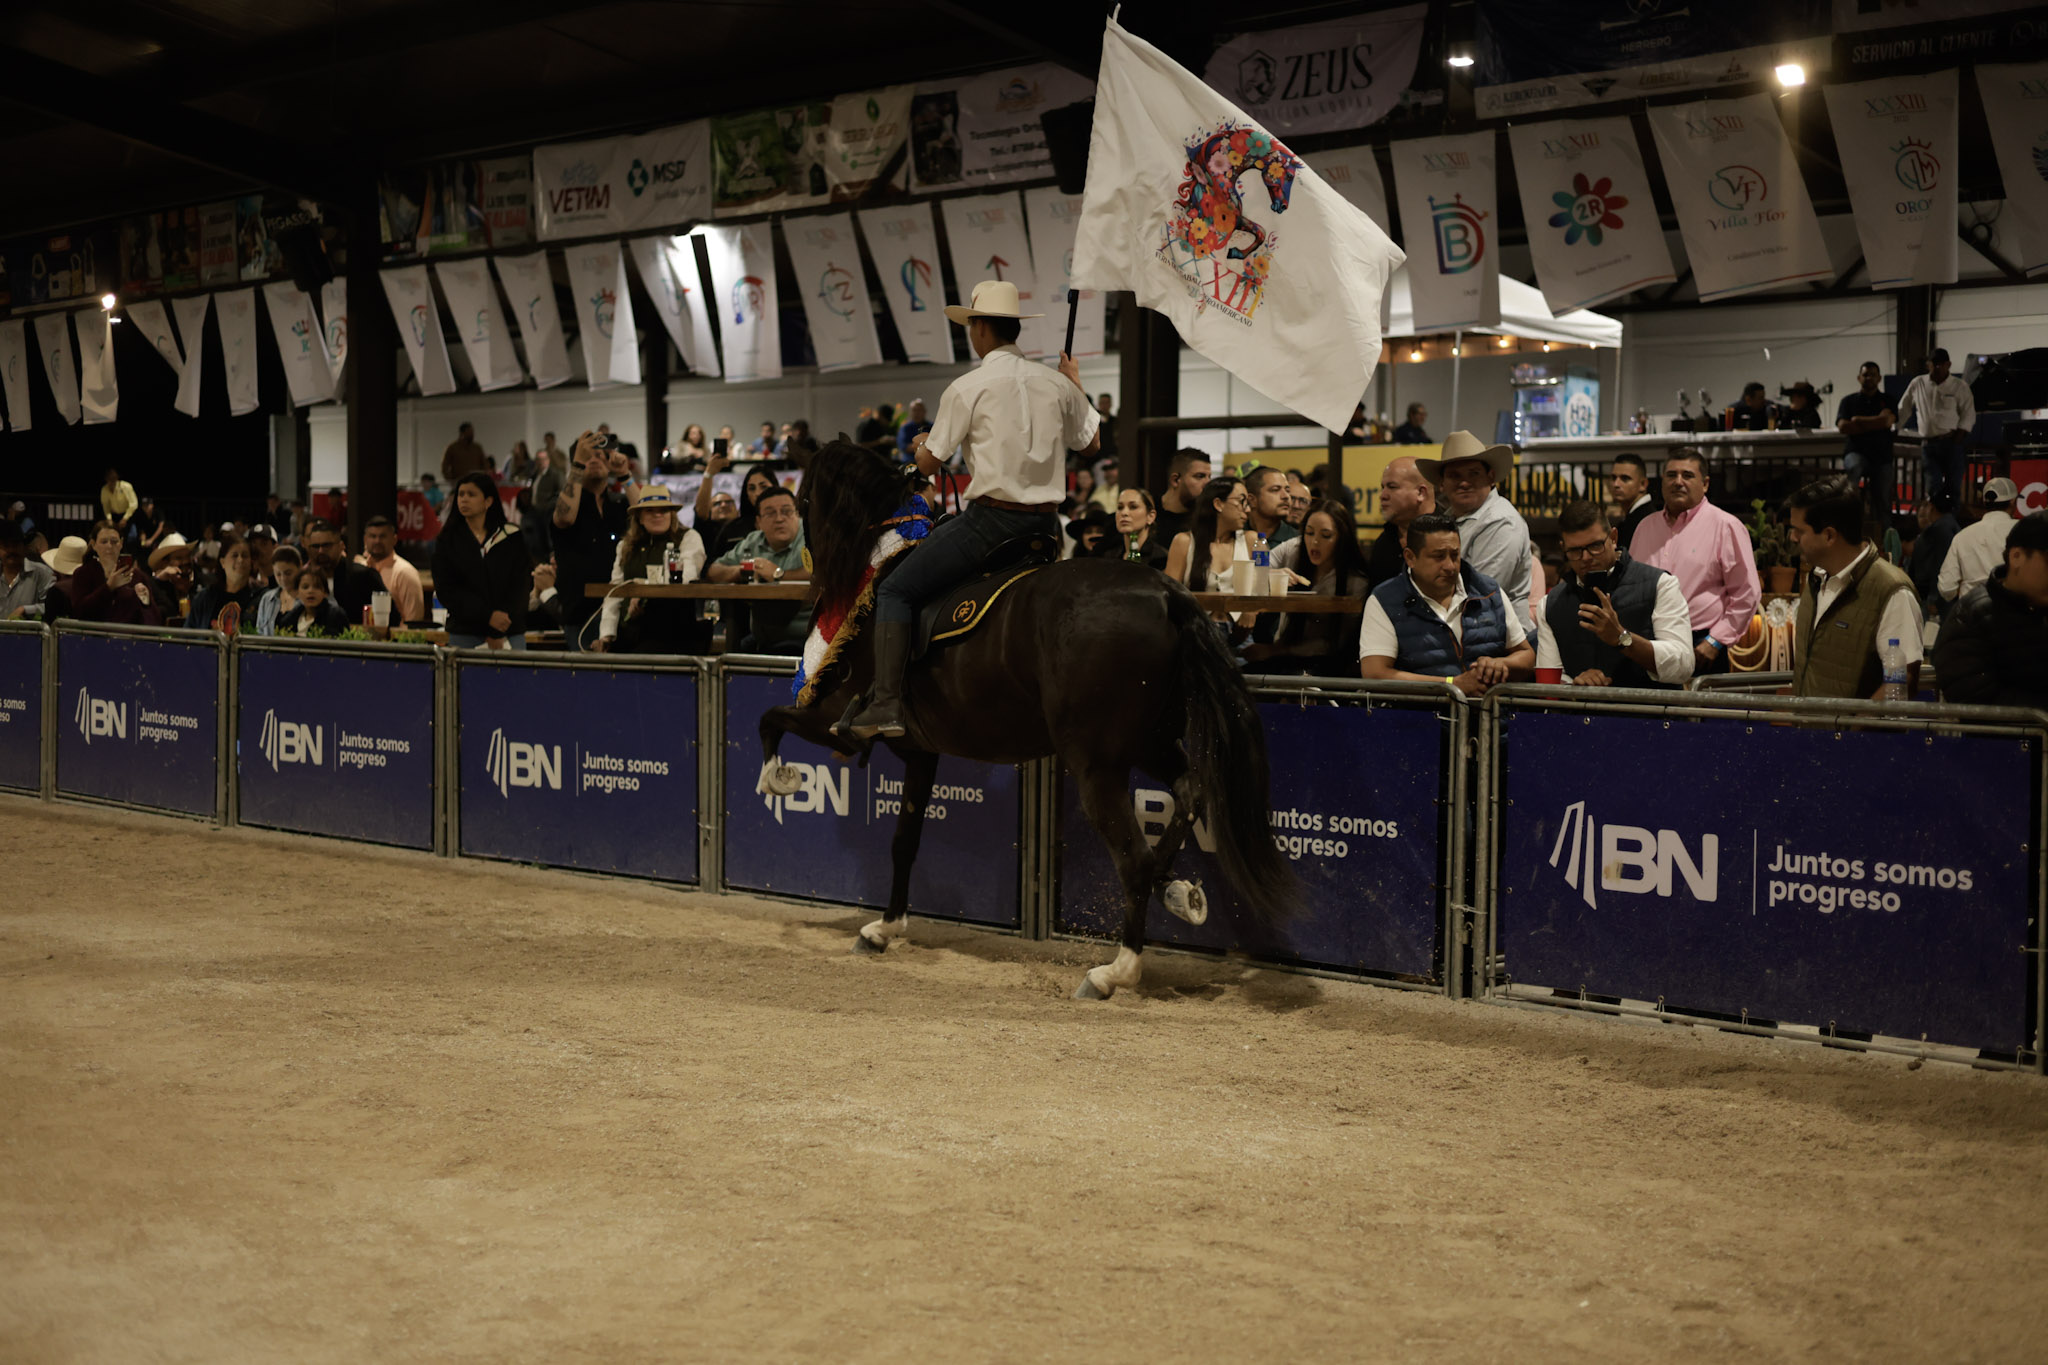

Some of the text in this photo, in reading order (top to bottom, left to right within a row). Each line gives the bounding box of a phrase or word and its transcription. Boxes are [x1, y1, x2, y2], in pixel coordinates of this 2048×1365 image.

[1852, 39, 1915, 64] SERVICIO
[1918, 38, 1934, 56] AL
[1281, 43, 1374, 101] ZEUS
[1575, 199, 1603, 221] 2R
[1707, 209, 1788, 231] Villa Flor
[90, 698, 128, 739] BN
[139, 706, 199, 730] Juntos somos
[140, 725, 179, 743] progreso
[279, 721, 323, 766] BN
[339, 730, 411, 754] Juntos somos
[339, 751, 387, 769] progreso
[509, 741, 563, 791] BN
[582, 750, 670, 776] Juntos somos
[583, 773, 641, 794] progreso
[784, 761, 850, 817] BN
[875, 773, 985, 803] Jun somos
[1269, 807, 1399, 839] untos somos
[1273, 833, 1349, 861] ogreso
[1601, 823, 1720, 903] BN
[1767, 844, 1974, 891] Juntos somos
[1768, 877, 1902, 914] progreso
